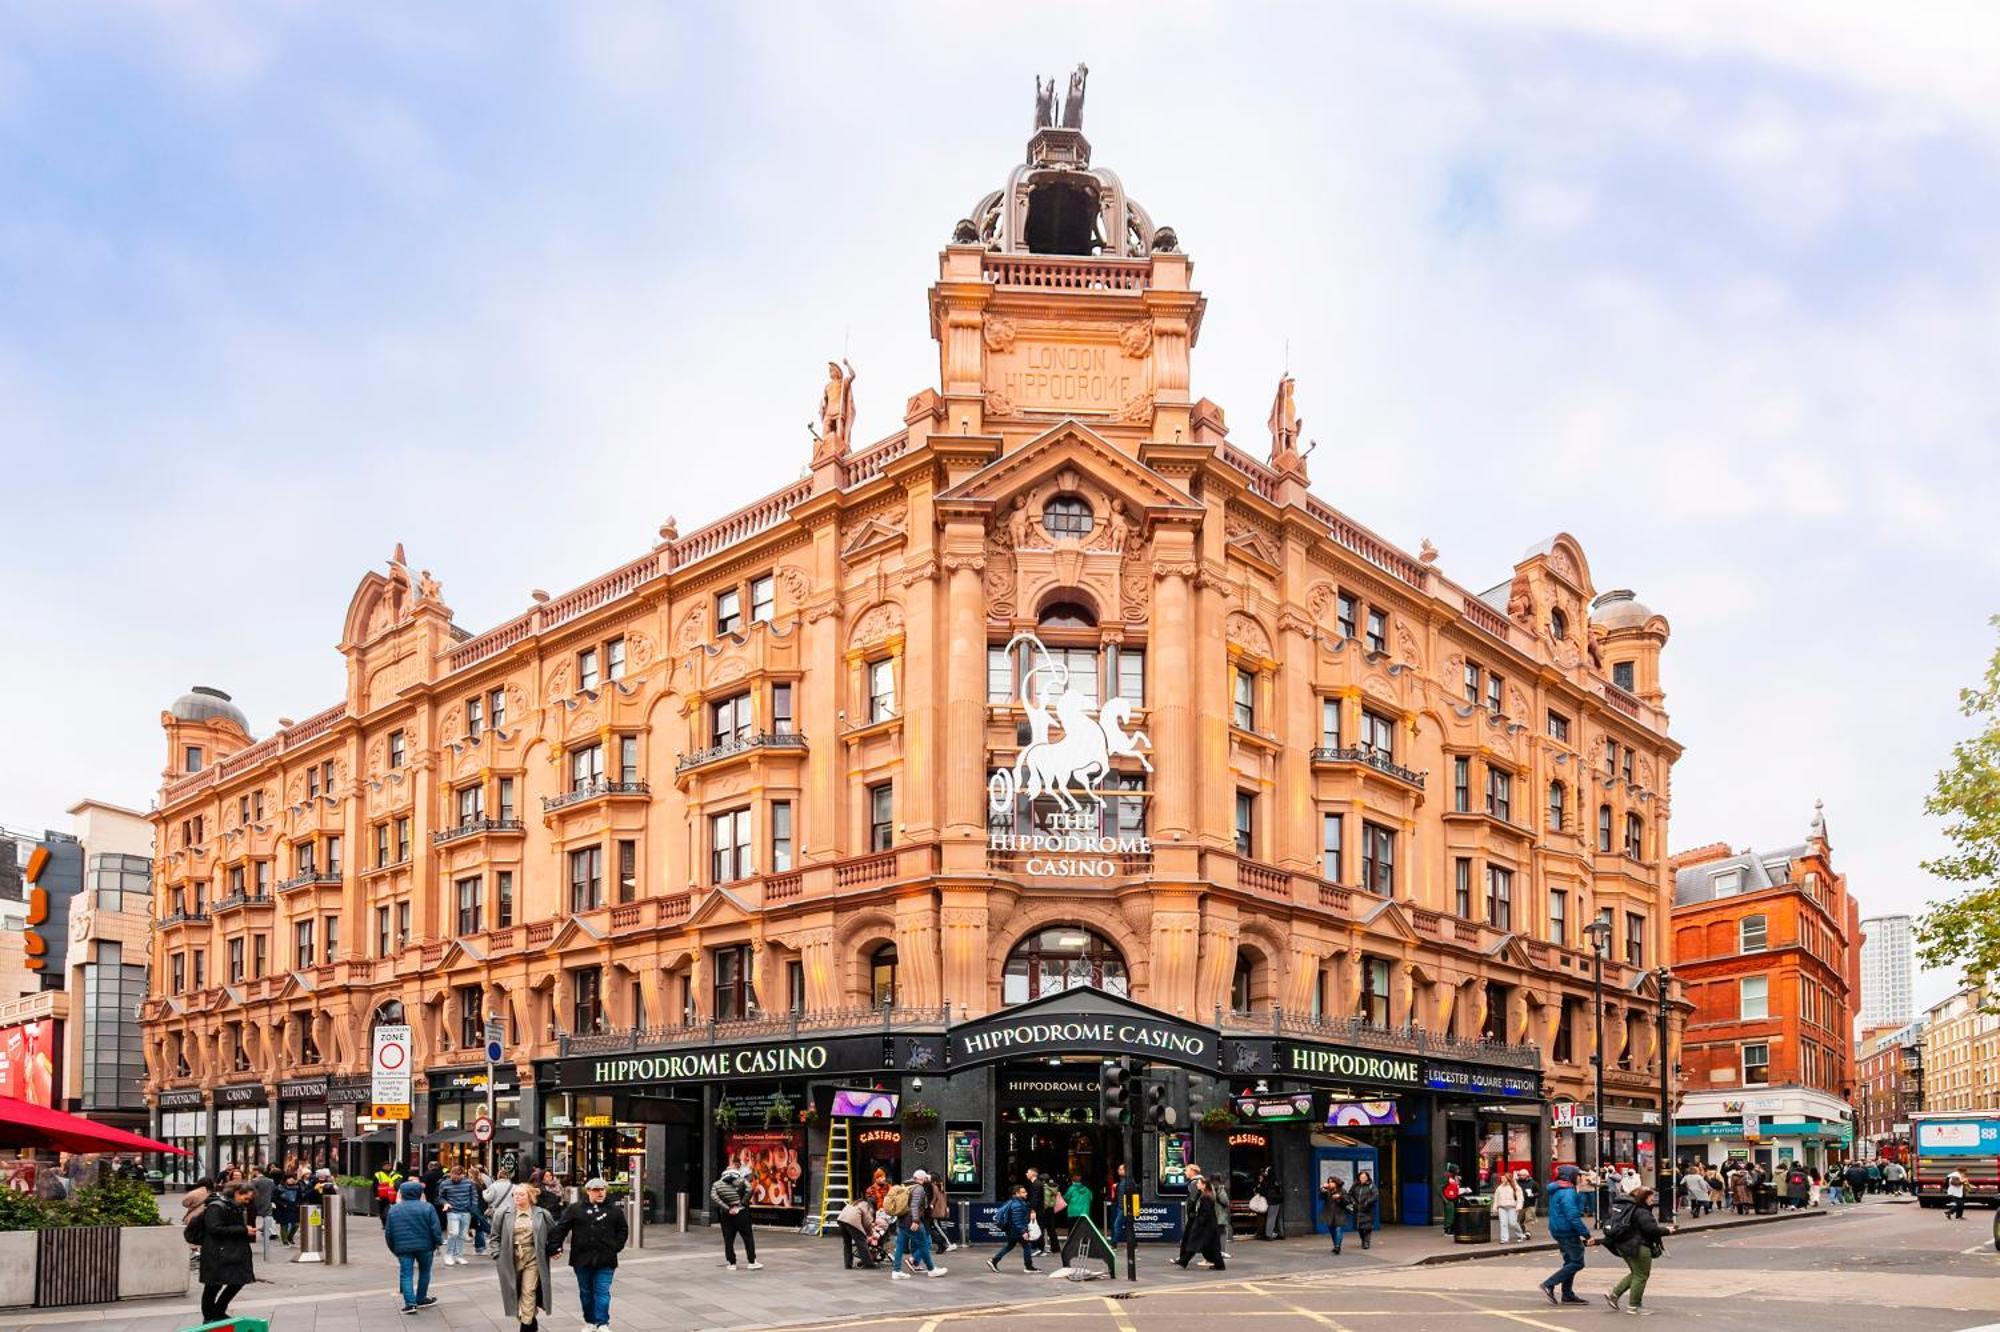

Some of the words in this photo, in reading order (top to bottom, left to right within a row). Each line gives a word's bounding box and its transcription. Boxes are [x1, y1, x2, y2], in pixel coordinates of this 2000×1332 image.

[1028, 347, 1106, 371] LONDON
[1004, 372, 1130, 401] HIPPODROME
[1048, 813, 1094, 830] THE
[990, 834, 1151, 853] HIPPODROME
[1026, 859, 1115, 877] CASINO
[381, 1033, 404, 1041] ZONE
[964, 1023, 1114, 1054] HIPPODROME
[1119, 1026, 1204, 1056] CASINO
[595, 1053, 729, 1082] HIPPODROME
[735, 1046, 827, 1074] CASINO
[1292, 1049, 1418, 1082] HIPPODROME
[1009, 1081, 1084, 1092] HIPPODROME
[1428, 1069, 1469, 1085] LEICESTER
[1472, 1075, 1503, 1088] SQUARE
[1505, 1078, 1534, 1091] STATION
[226, 1088, 252, 1101] CASINO
[584, 1115, 610, 1127] COFFEE
[1586, 1116, 1594, 1126] P
[859, 1130, 901, 1143] CASINO
[1228, 1133, 1266, 1146] CASINO
[1981, 1127, 1998, 1140] 88
